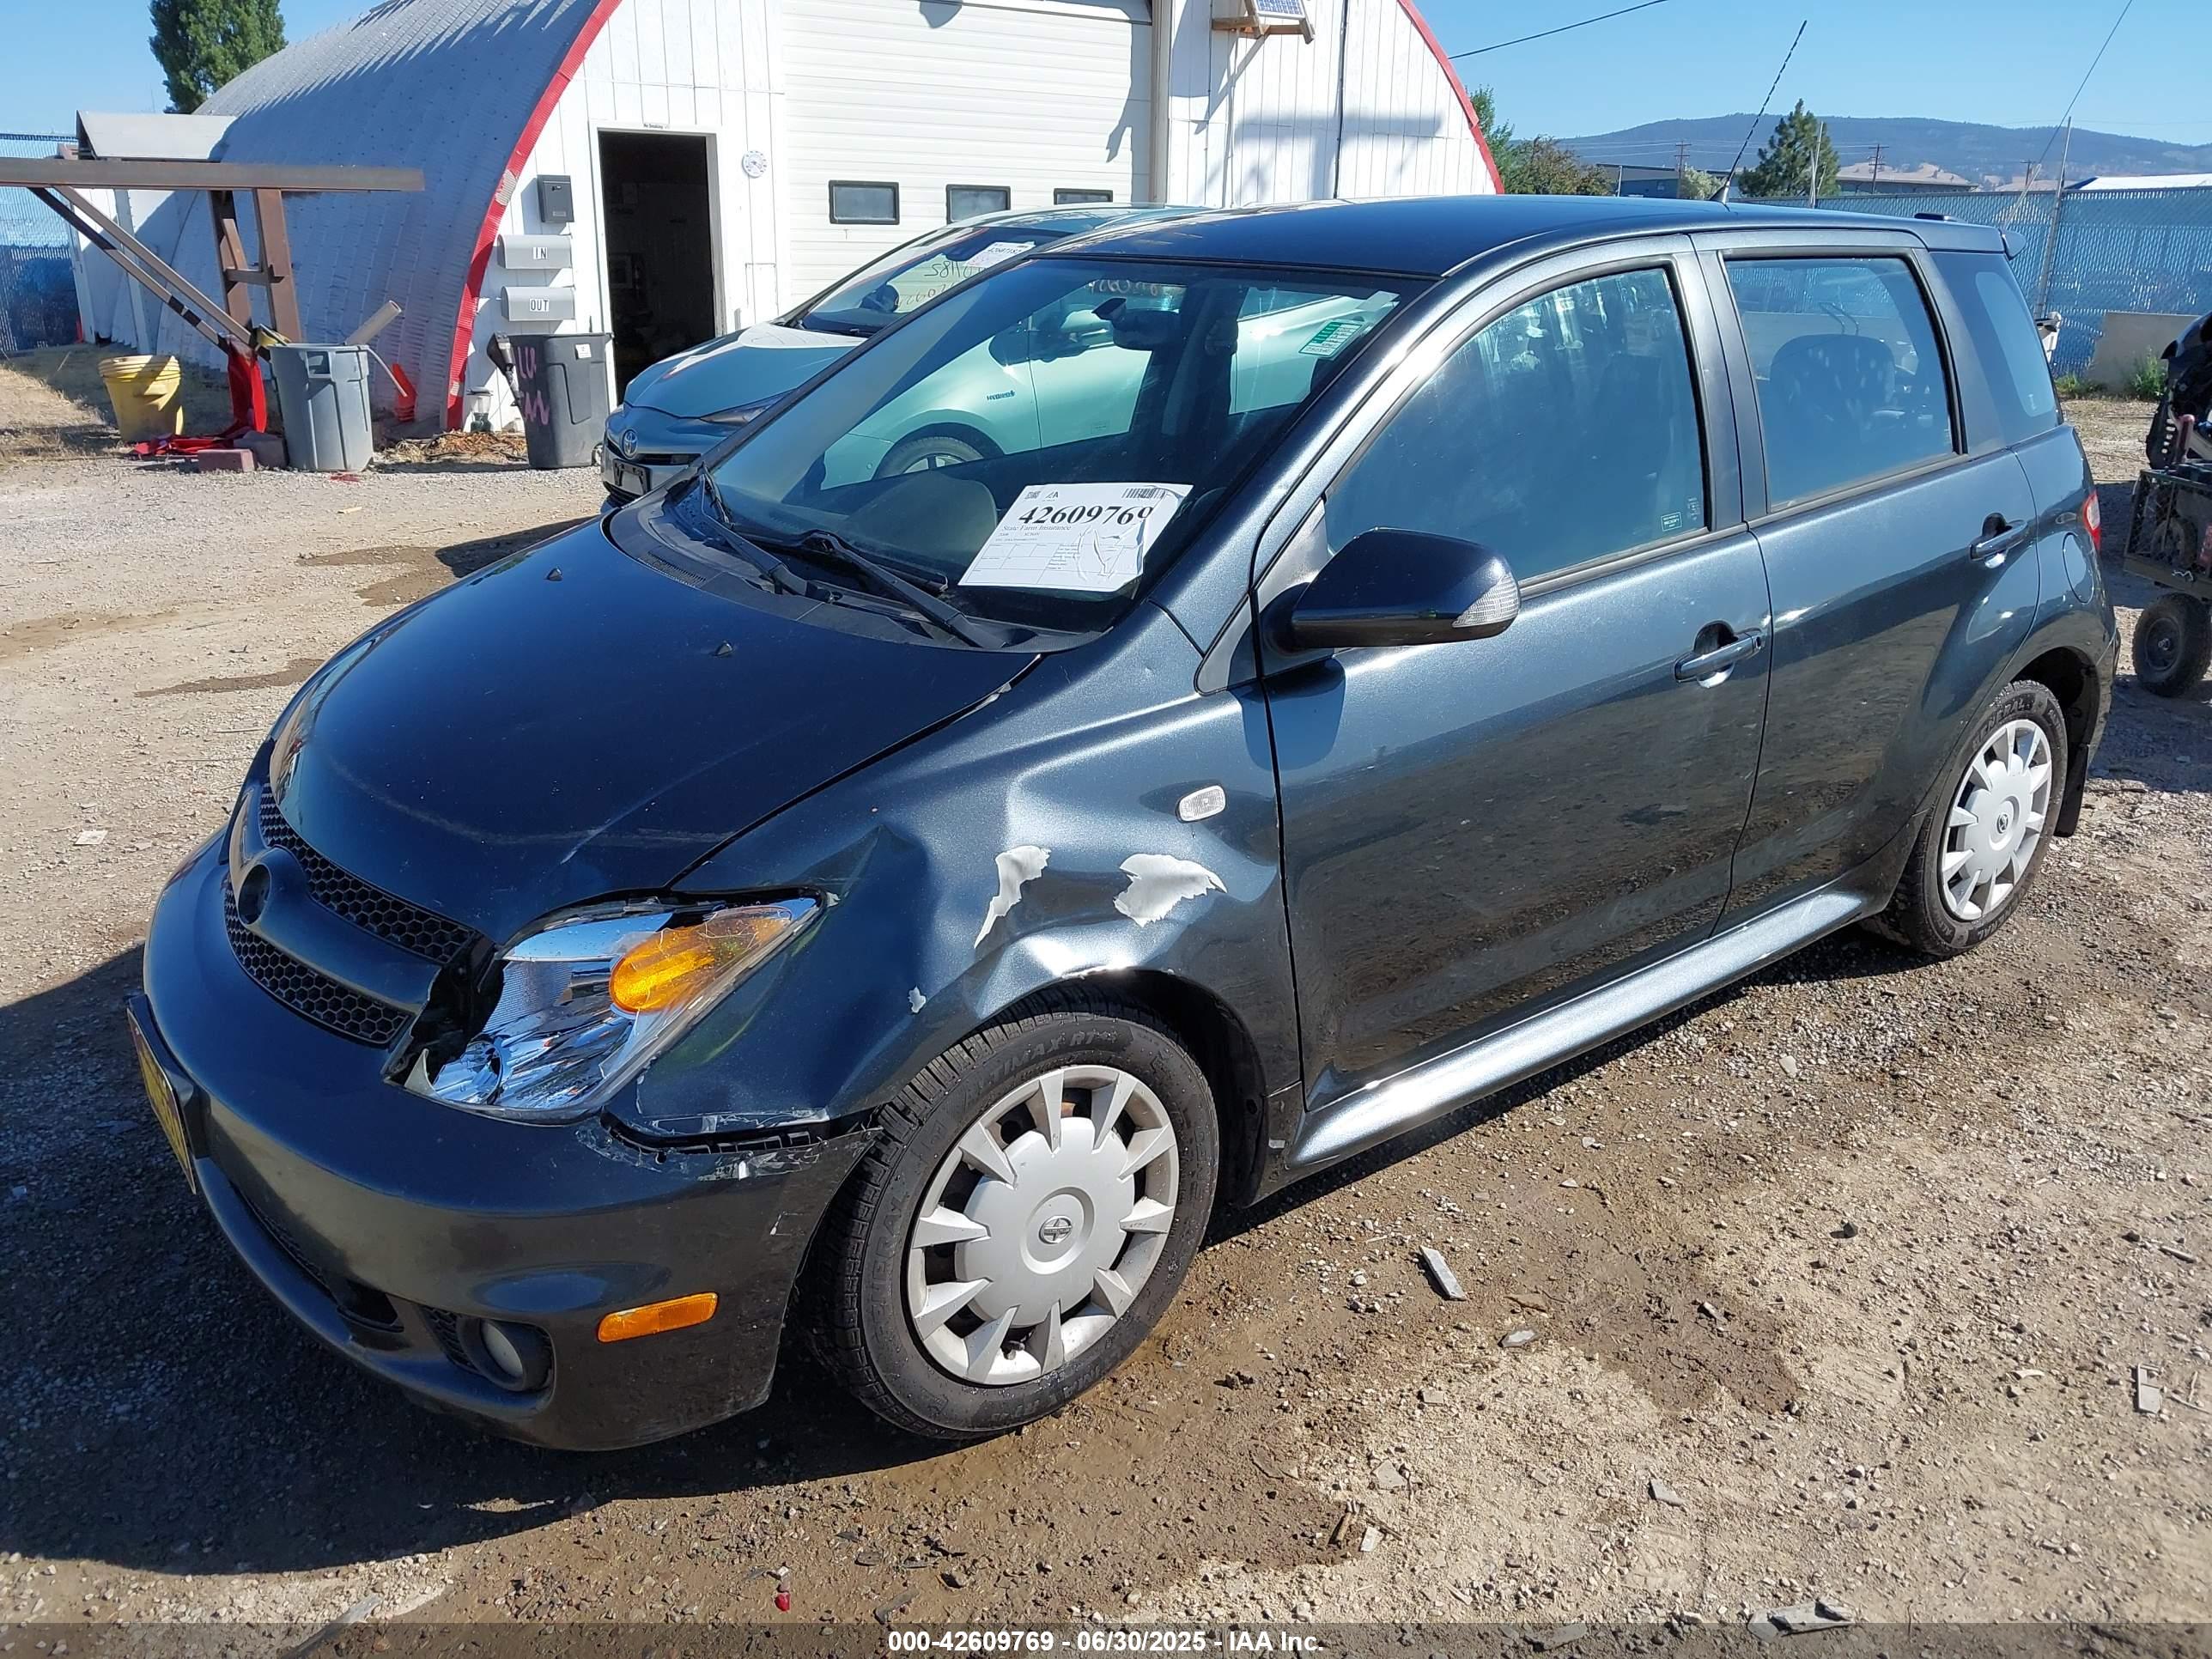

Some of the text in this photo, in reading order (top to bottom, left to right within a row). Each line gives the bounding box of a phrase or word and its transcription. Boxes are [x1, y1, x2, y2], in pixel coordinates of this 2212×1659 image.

[534, 246, 547, 259] IN
[531, 299, 549, 311] OUT
[1018, 505, 1154, 525] 42609769
